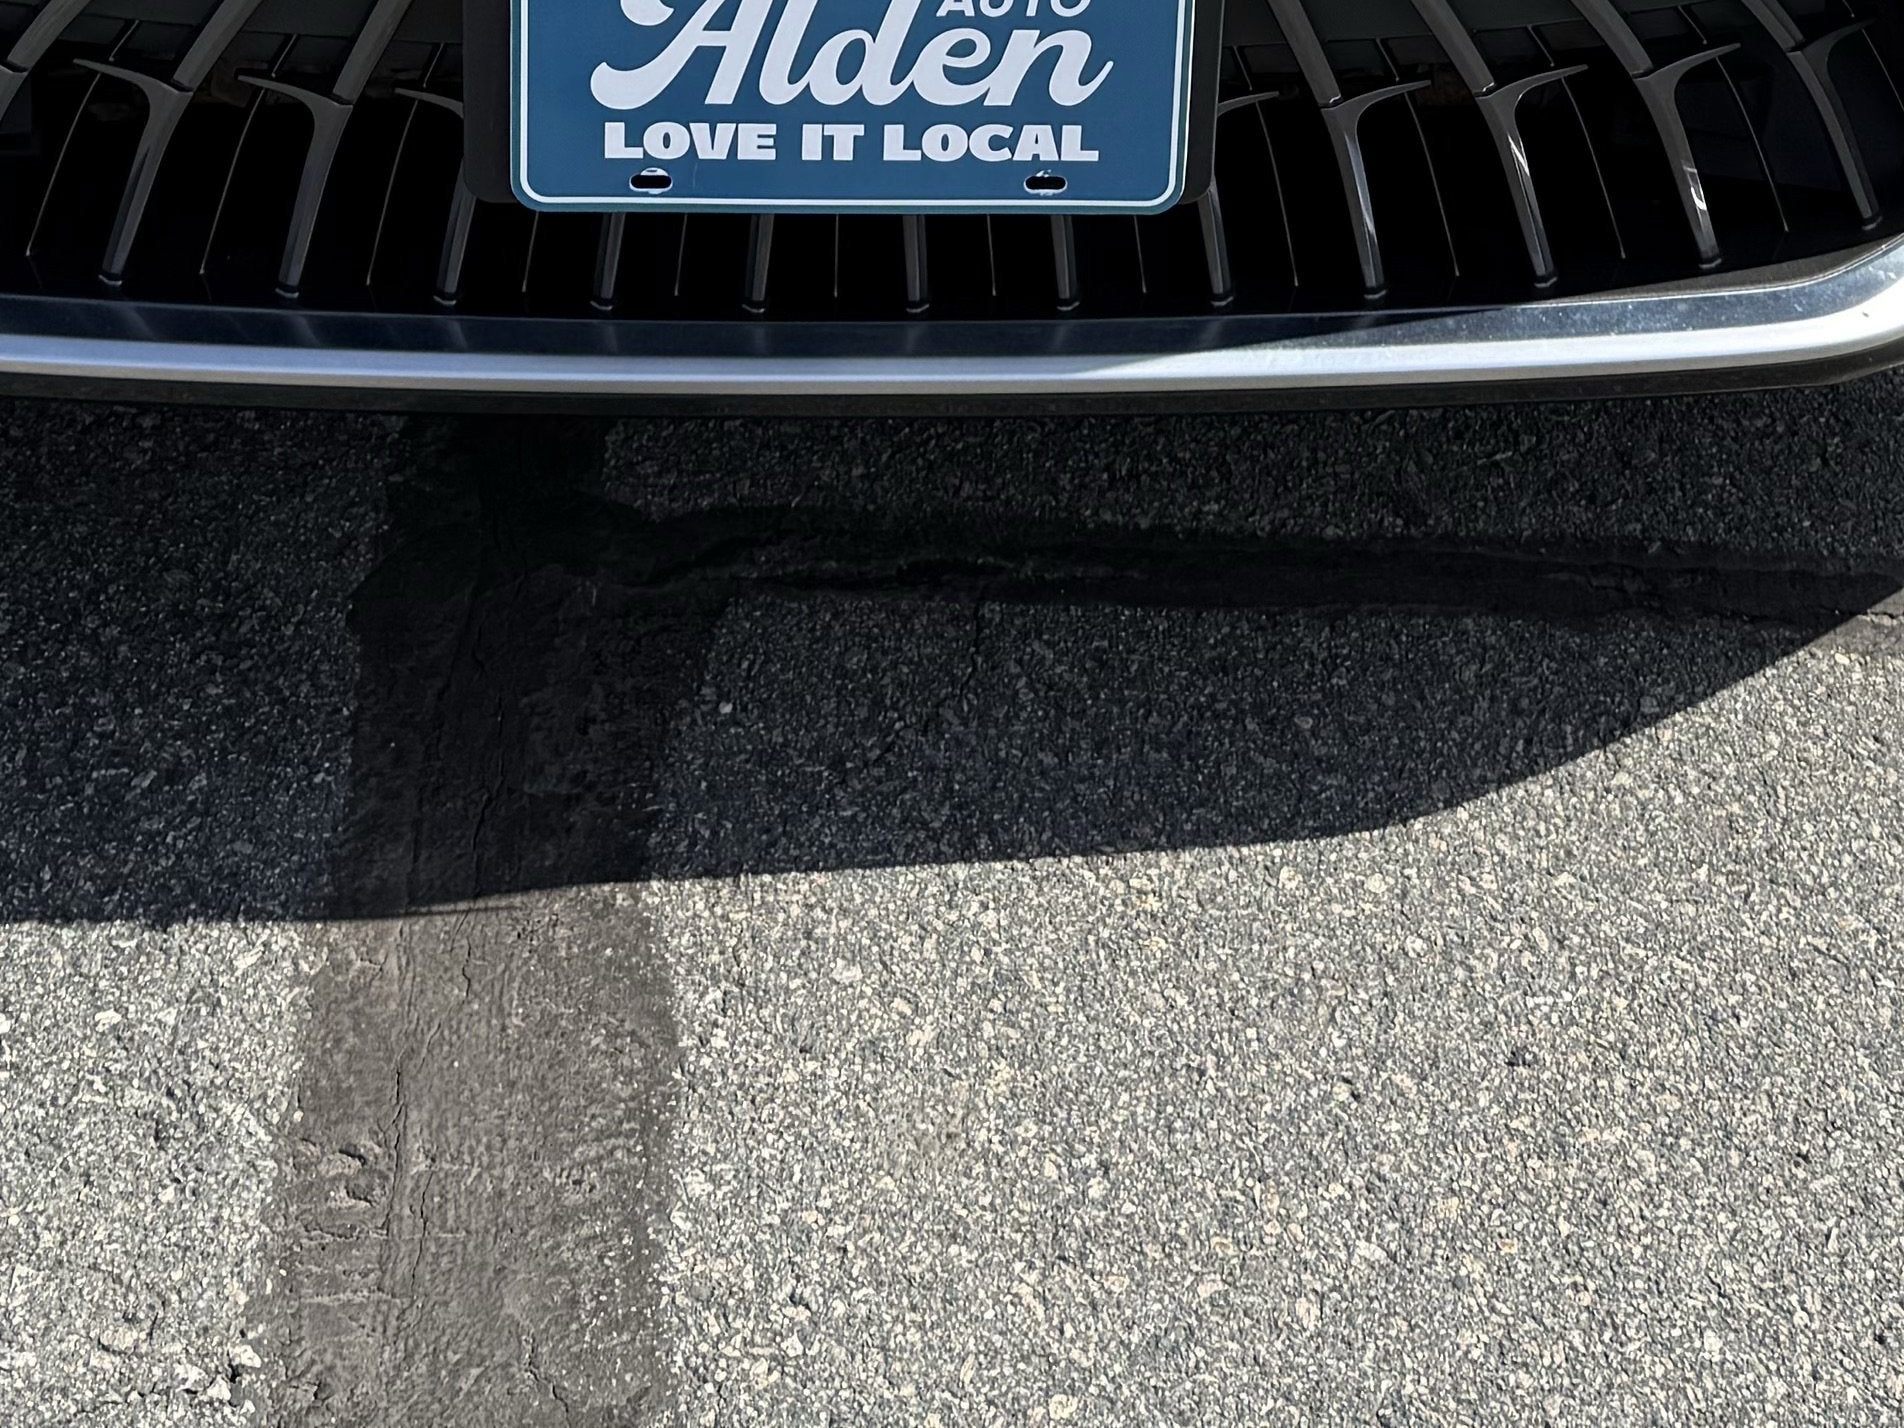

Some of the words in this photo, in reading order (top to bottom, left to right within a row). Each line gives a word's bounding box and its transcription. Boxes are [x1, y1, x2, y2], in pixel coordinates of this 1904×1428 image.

[603, 121, 777, 161] LOVE
[801, 122, 865, 161] IT
[882, 123, 1100, 162] LOCAL
